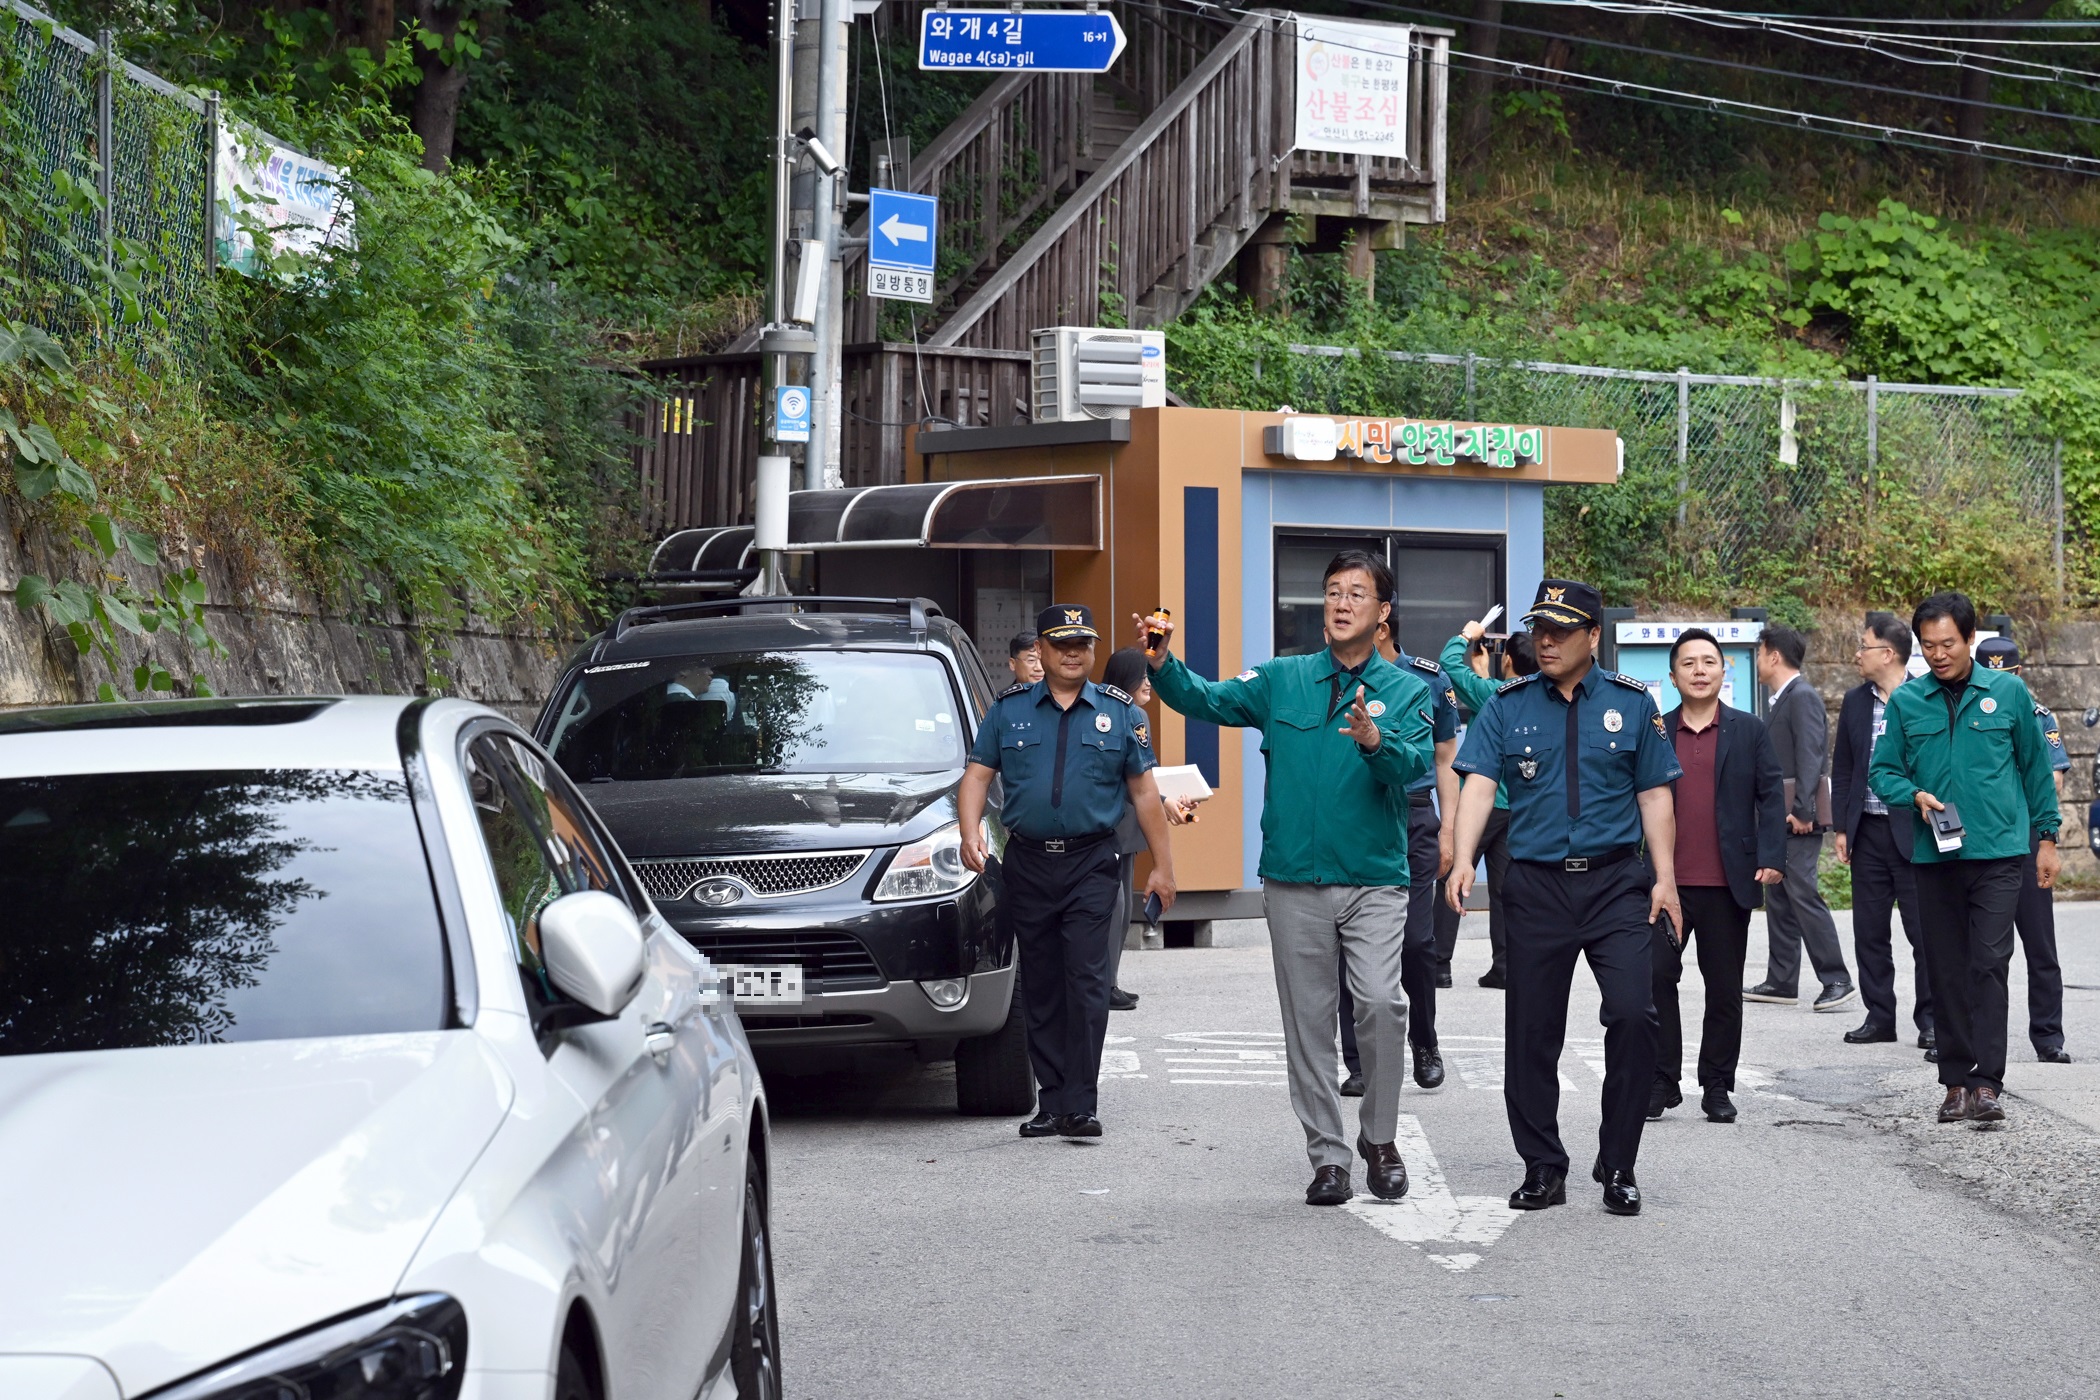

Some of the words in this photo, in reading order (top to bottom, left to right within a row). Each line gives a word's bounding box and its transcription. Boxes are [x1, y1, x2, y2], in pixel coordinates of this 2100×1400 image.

[929, 50, 972, 66] Wagae
[976, 51, 1034, 67] 4(sa)-gil
[1305, 88, 1399, 127] 산불조심
[875, 273, 928, 295] 일방통행
[1337, 420, 1393, 464] 시민
[1401, 422, 1456, 465] 안전
[1464, 425, 1543, 469] 지킴이
